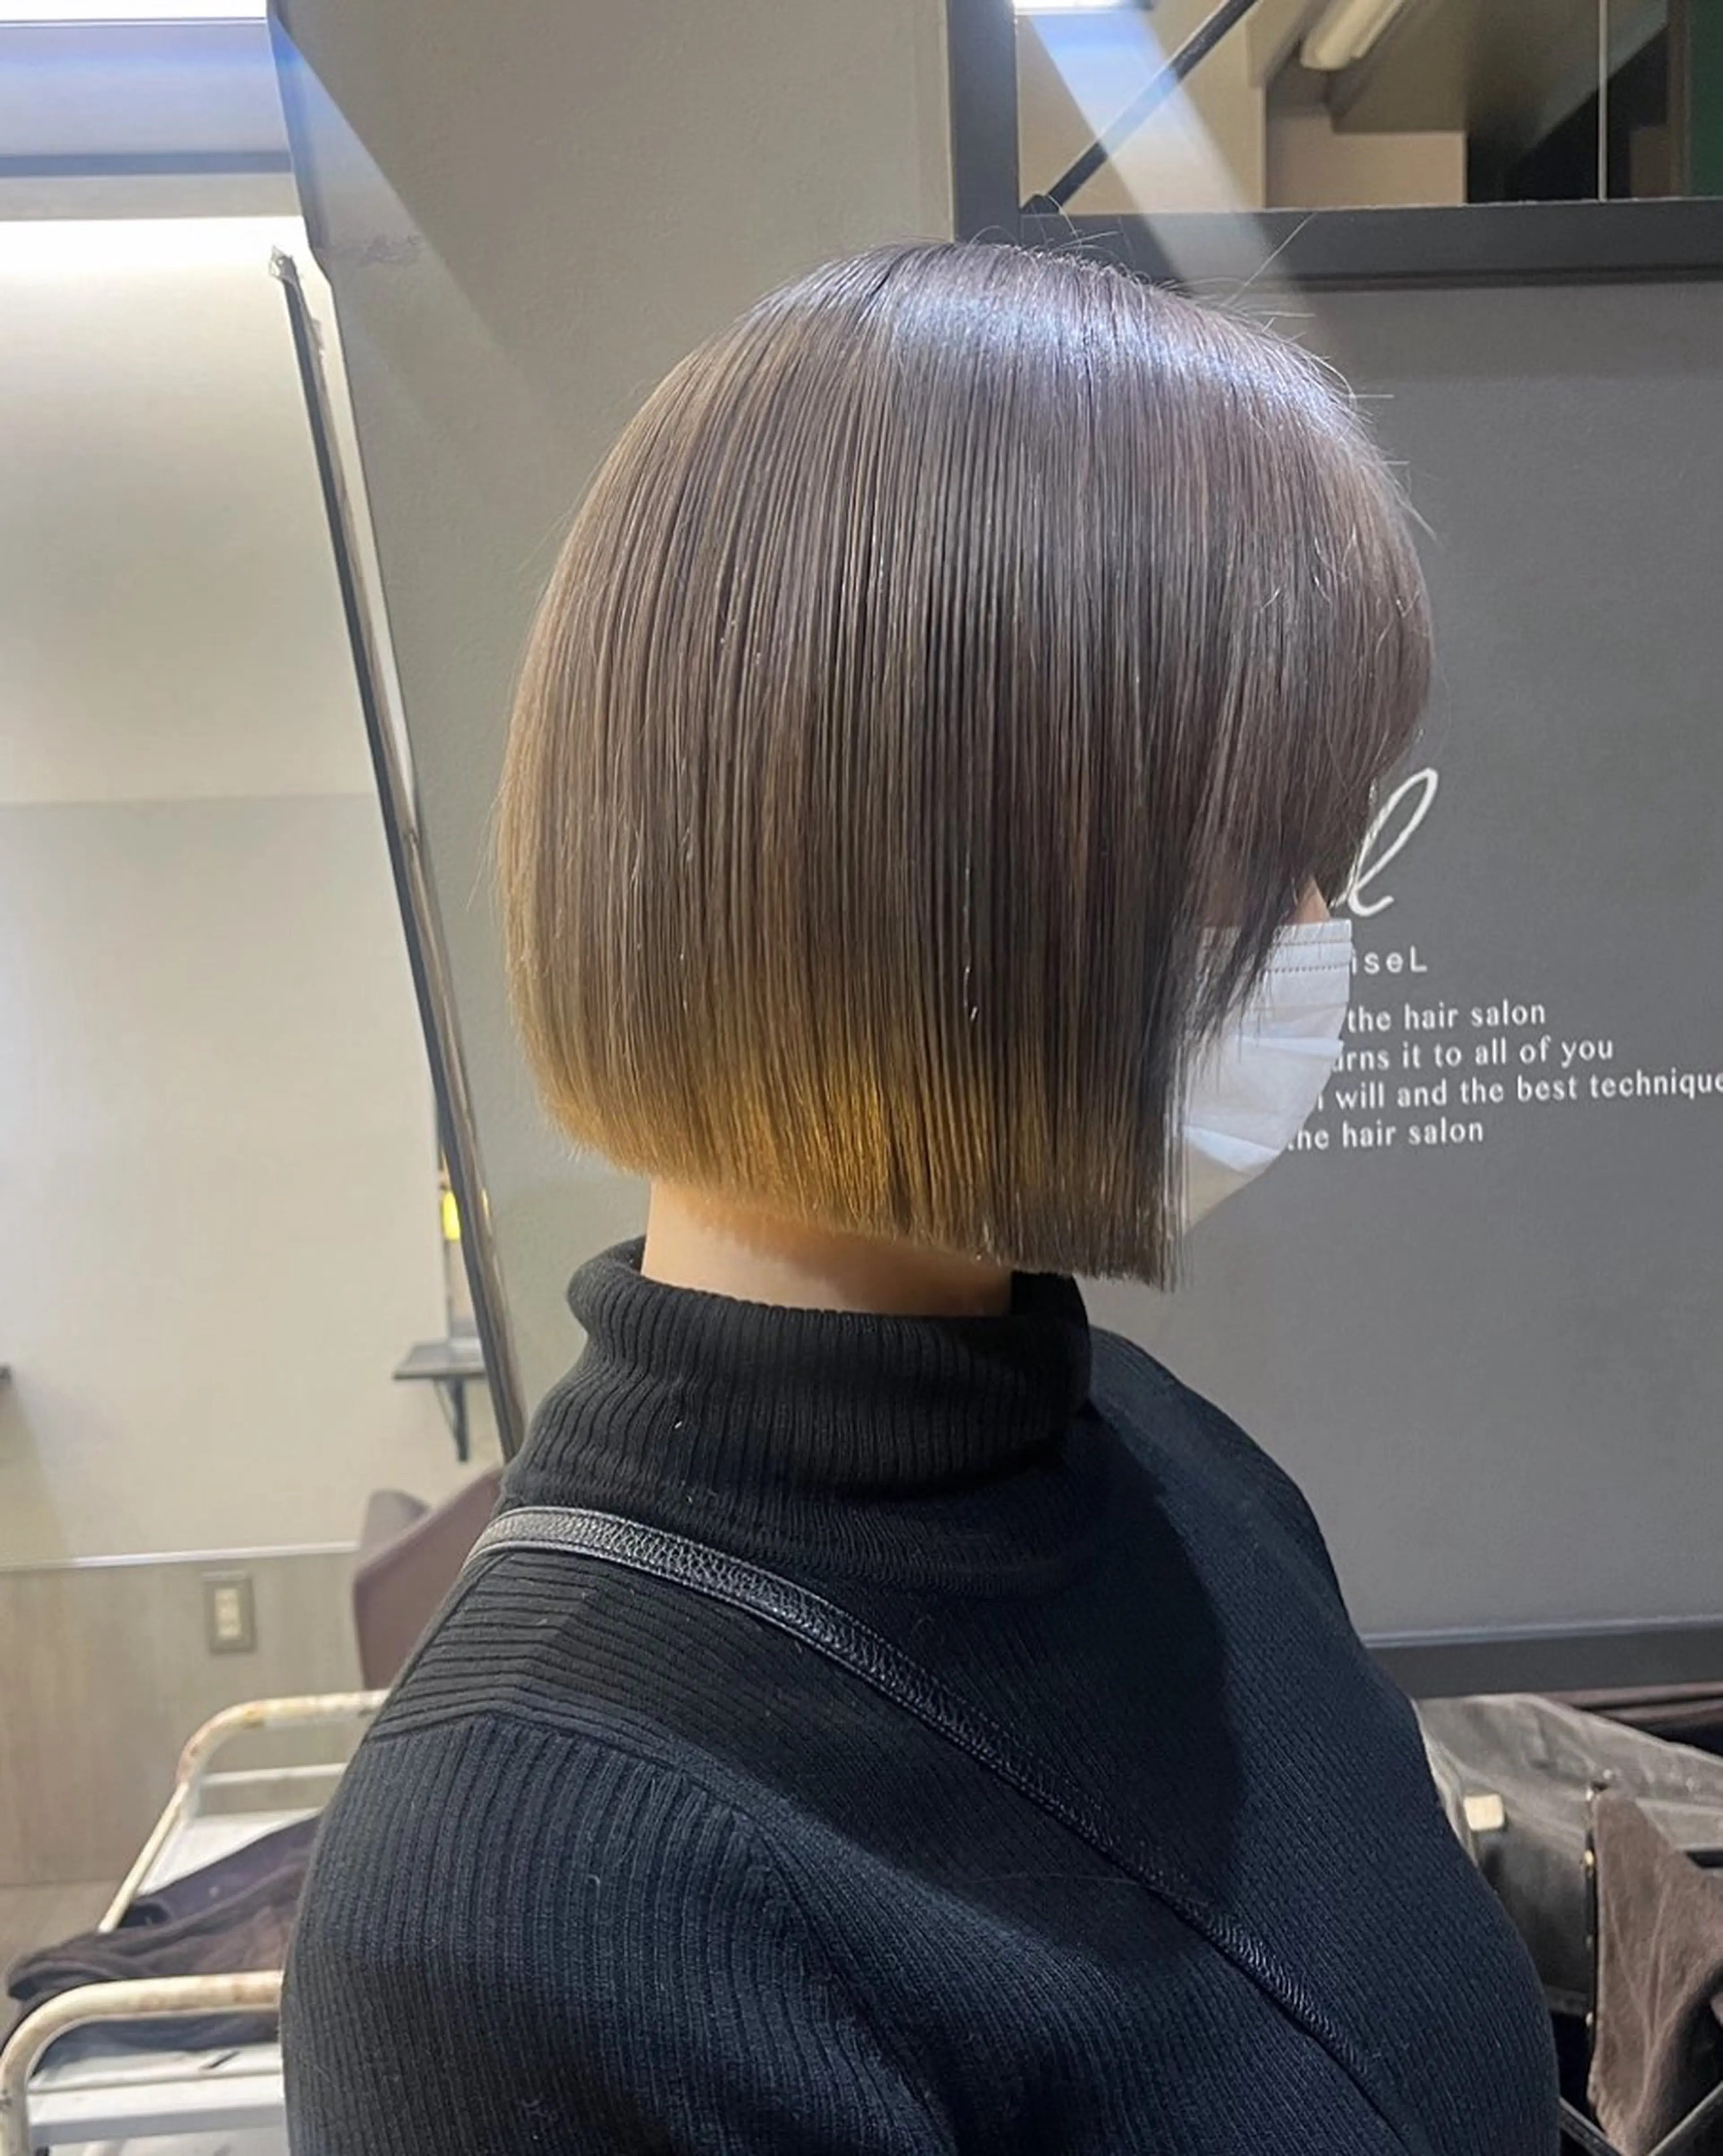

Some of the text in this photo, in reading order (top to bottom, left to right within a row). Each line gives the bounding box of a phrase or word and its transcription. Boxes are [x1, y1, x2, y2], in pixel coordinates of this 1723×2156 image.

[1348, 998, 1546, 1032] the hair salon
[1403, 1040, 1420, 1069] it
[1434, 1043, 1462, 1068] to
[1475, 1036, 1506, 1066] all
[1519, 1034, 1551, 1064] of
[1561, 1039, 1613, 1069] you
[1335, 1081, 1384, 1110] will
[1397, 1078, 1447, 1108] and
[1460, 1077, 1504, 1104] the
[1517, 1074, 1577, 1102] best
[1343, 1119, 1396, 1148] hair
[1408, 1116, 1483, 1145] salon
